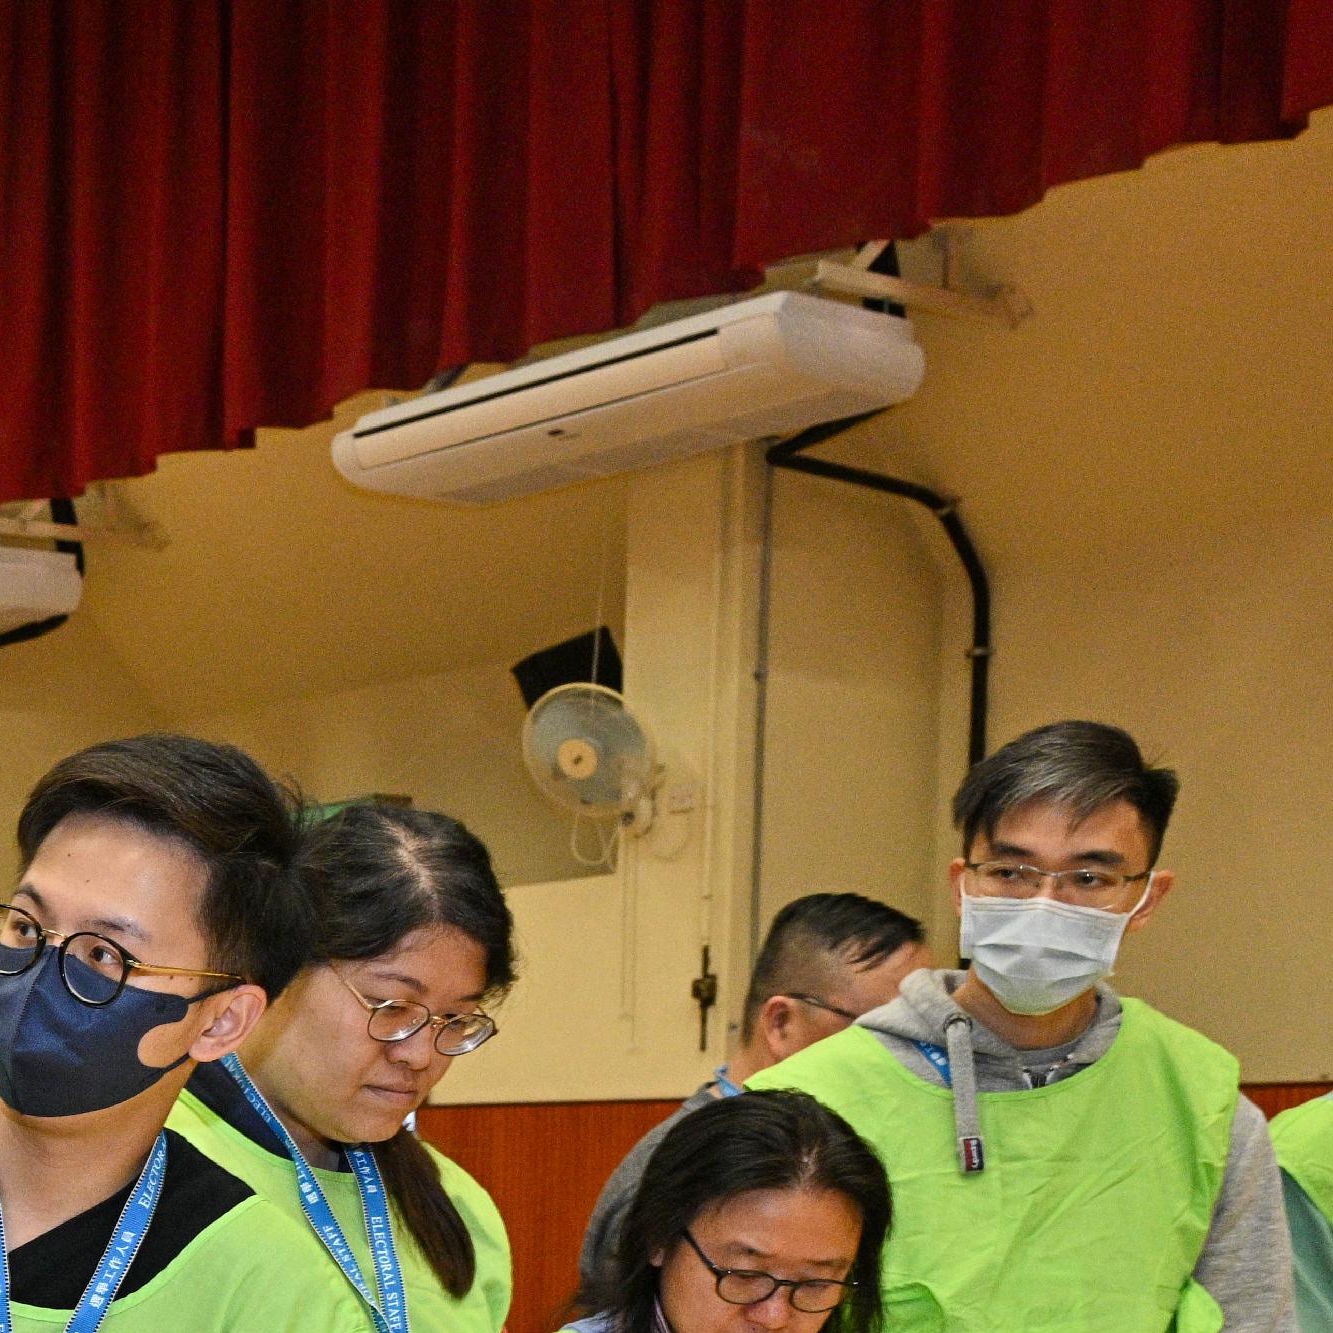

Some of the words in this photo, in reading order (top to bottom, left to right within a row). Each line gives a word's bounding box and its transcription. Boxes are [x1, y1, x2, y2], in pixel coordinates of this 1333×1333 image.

[90, 1231, 136, 1309] 選舉工作人員
[323, 1225, 350, 1263] STAFF
[371, 1216, 396, 1290] ELECTORAL
[386, 1292, 403, 1330] STAFF
